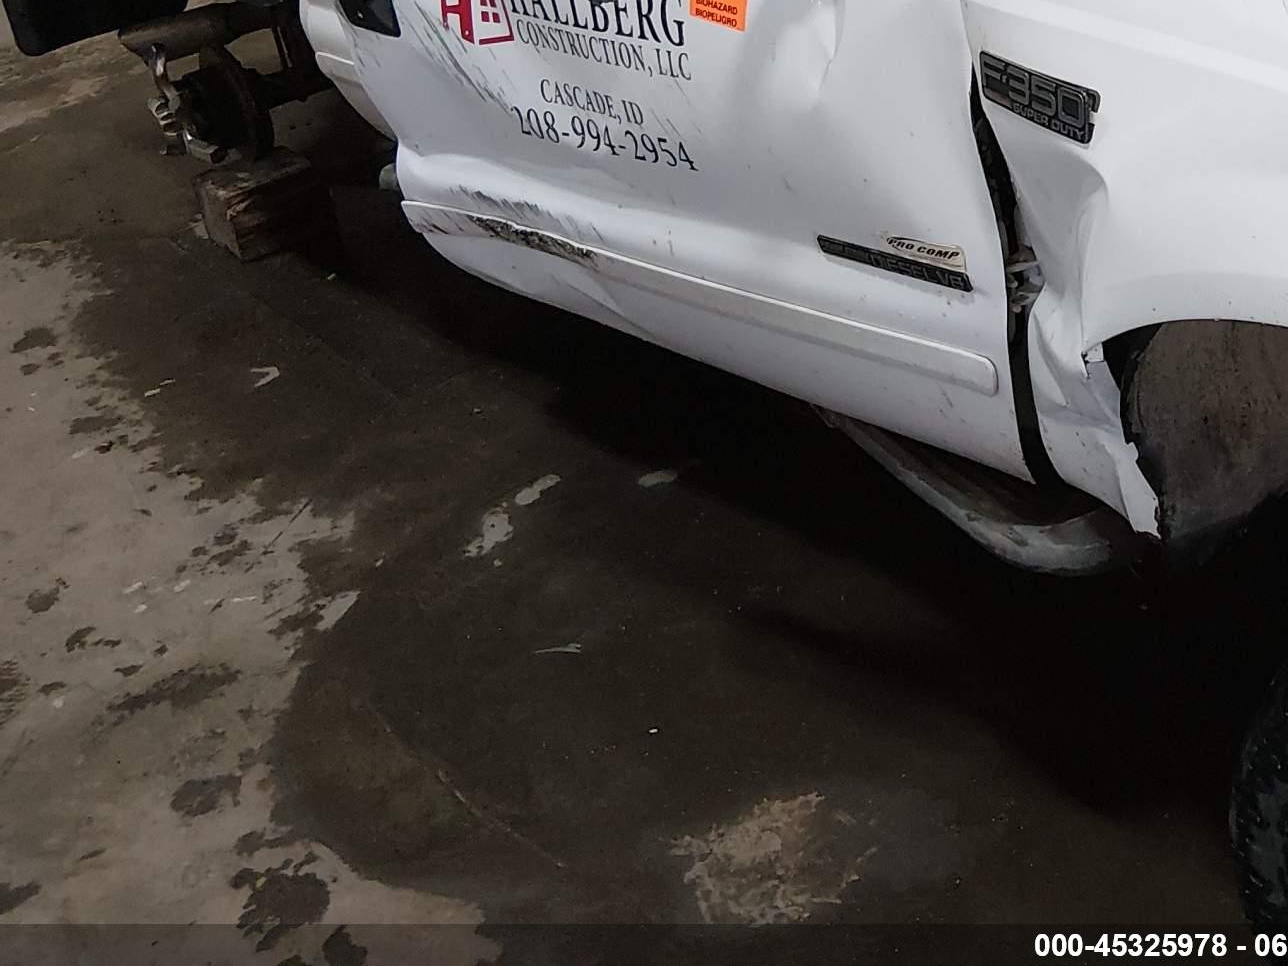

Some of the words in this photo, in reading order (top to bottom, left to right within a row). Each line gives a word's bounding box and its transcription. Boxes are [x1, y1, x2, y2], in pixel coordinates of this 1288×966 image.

[695, 8, 738, 27] BIOPELIGRO
[516, 19, 653, 77] CONSTRUCTION,
[655, 48, 692, 81] LLC
[540, 79, 621, 124] CASCADE,
[621, 100, 644, 126] ID
[511, 106, 700, 171] 208-994-2954
[1012, 103, 1049, 126] SUPER
[1051, 119, 1086, 141] DUTY
[869, 252, 934, 282] DIESEL
[888, 237, 914, 251] PRO
[916, 245, 961, 260] COMP
